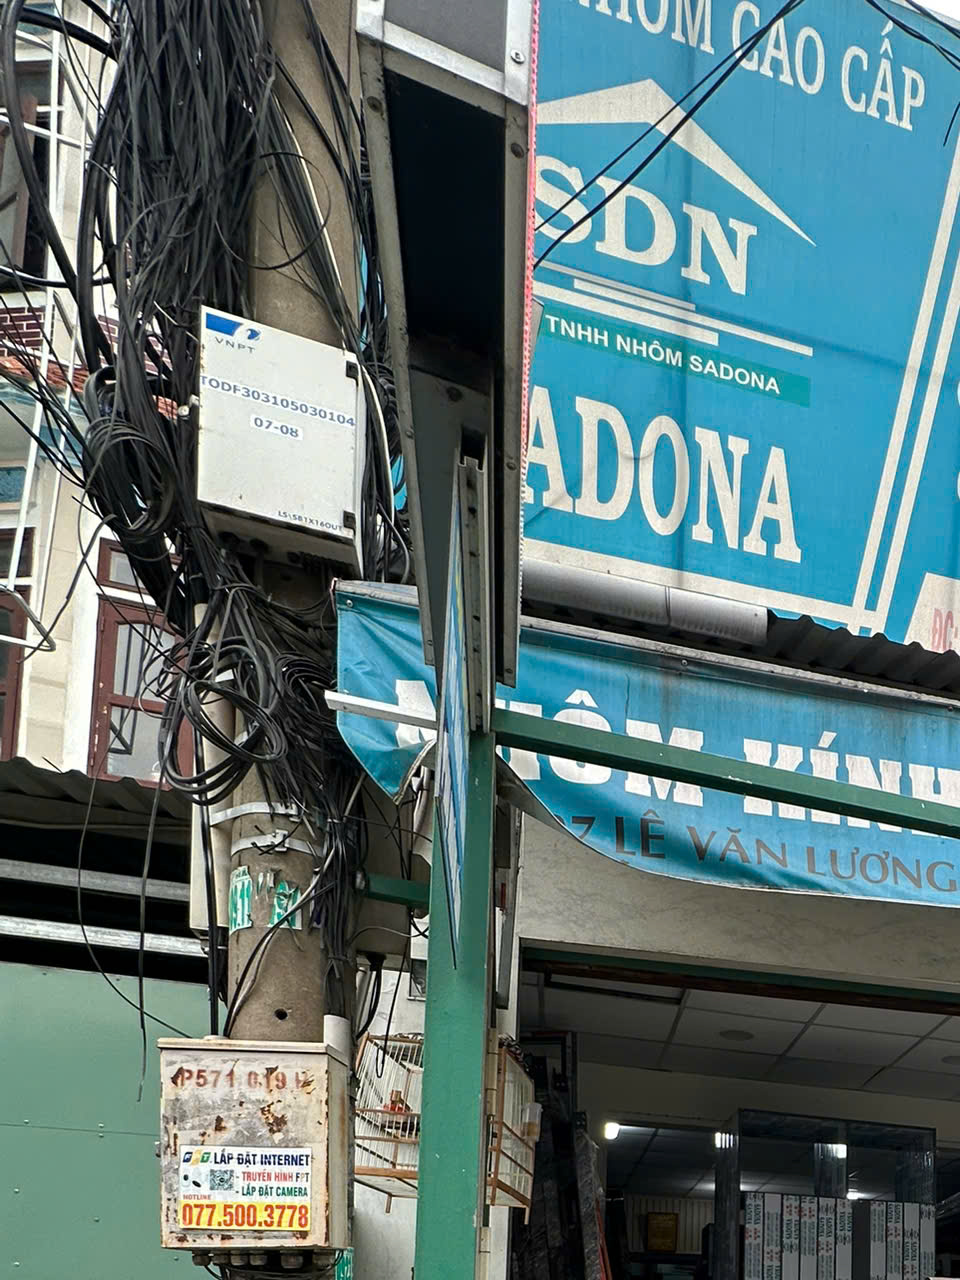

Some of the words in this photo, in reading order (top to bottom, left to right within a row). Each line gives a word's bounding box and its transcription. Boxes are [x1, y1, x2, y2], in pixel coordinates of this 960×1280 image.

[731, 1, 825, 95] CAO
[841, 21, 927, 131] CẤP
[534, 154, 758, 296] SDN
[215, 336, 256, 354] VNPT
[545, 315, 610, 348] TNHH
[616, 332, 684, 368] NHÔM
[689, 355, 781, 395] SADONA
[201, 375, 356, 428] TODF303105030104
[253, 416, 300, 438] 07-08
[615, 809, 666, 859] LÊ
[687, 826, 790, 870] VĂN
[213, 1148, 234, 1165] LẮP
[237, 1152, 258, 1168] ĐẶT
[260, 1154, 310, 1166] INTERNET
[295, 1172, 310, 1182] FPT
[275, 1186, 309, 1197] CAMERA
[182, 1203, 309, 1228] 077.500.3778
